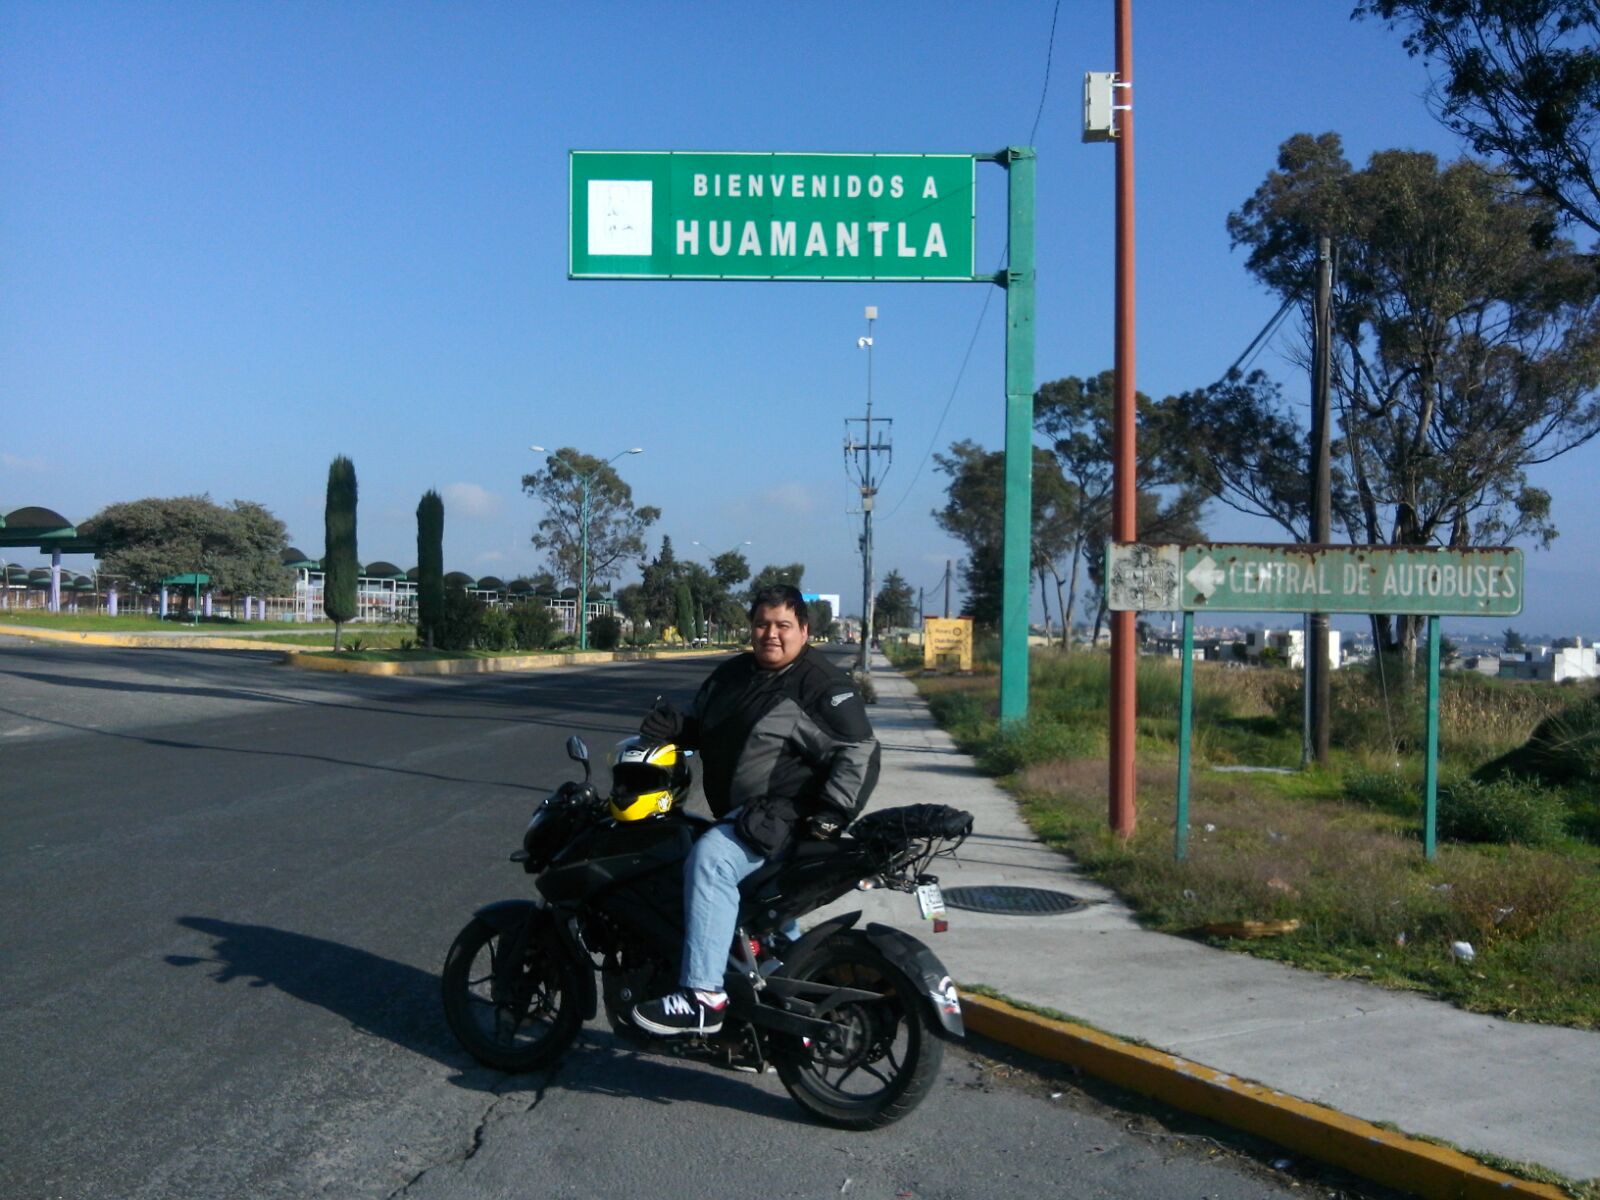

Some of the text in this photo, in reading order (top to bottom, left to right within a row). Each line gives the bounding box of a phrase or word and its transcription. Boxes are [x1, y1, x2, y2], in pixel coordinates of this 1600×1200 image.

[693, 173, 938, 199] BIENVENIDOS A
[676, 219, 948, 258] HUAMANTLA
[1229, 561, 1516, 598] CENTRAL DE AUTOBUSES
